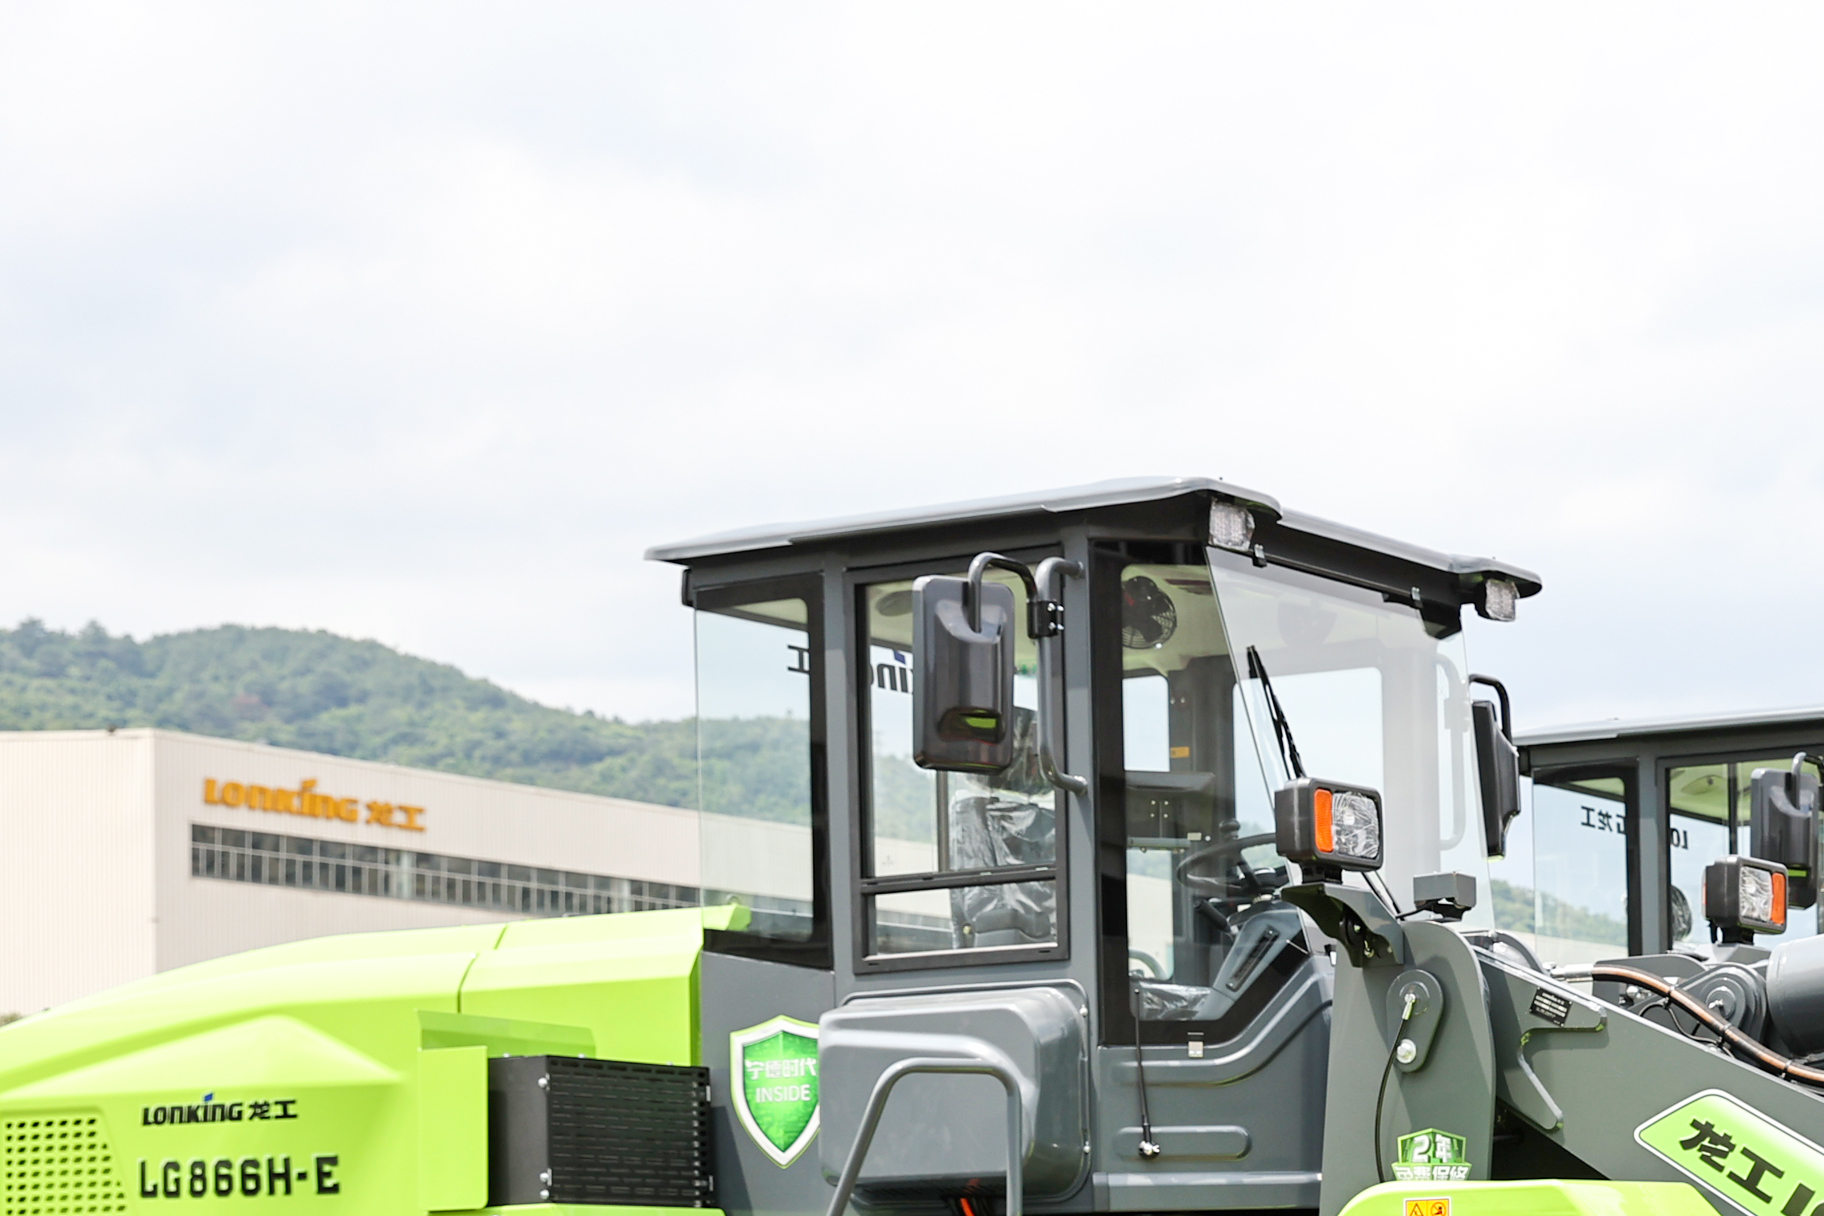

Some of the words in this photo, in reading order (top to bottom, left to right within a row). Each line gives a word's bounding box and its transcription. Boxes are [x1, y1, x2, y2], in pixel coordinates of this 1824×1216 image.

[366, 800, 426, 832] 龙工
[744, 1056, 818, 1080] 宁德时代
[755, 1083, 811, 1103] INSIDE
[248, 1099, 298, 1121] 龙工
[1411, 1132, 1453, 1164] 2年
[1679, 1117, 1785, 1205] 龙工
[139, 1155, 341, 1199] LG866H-E
